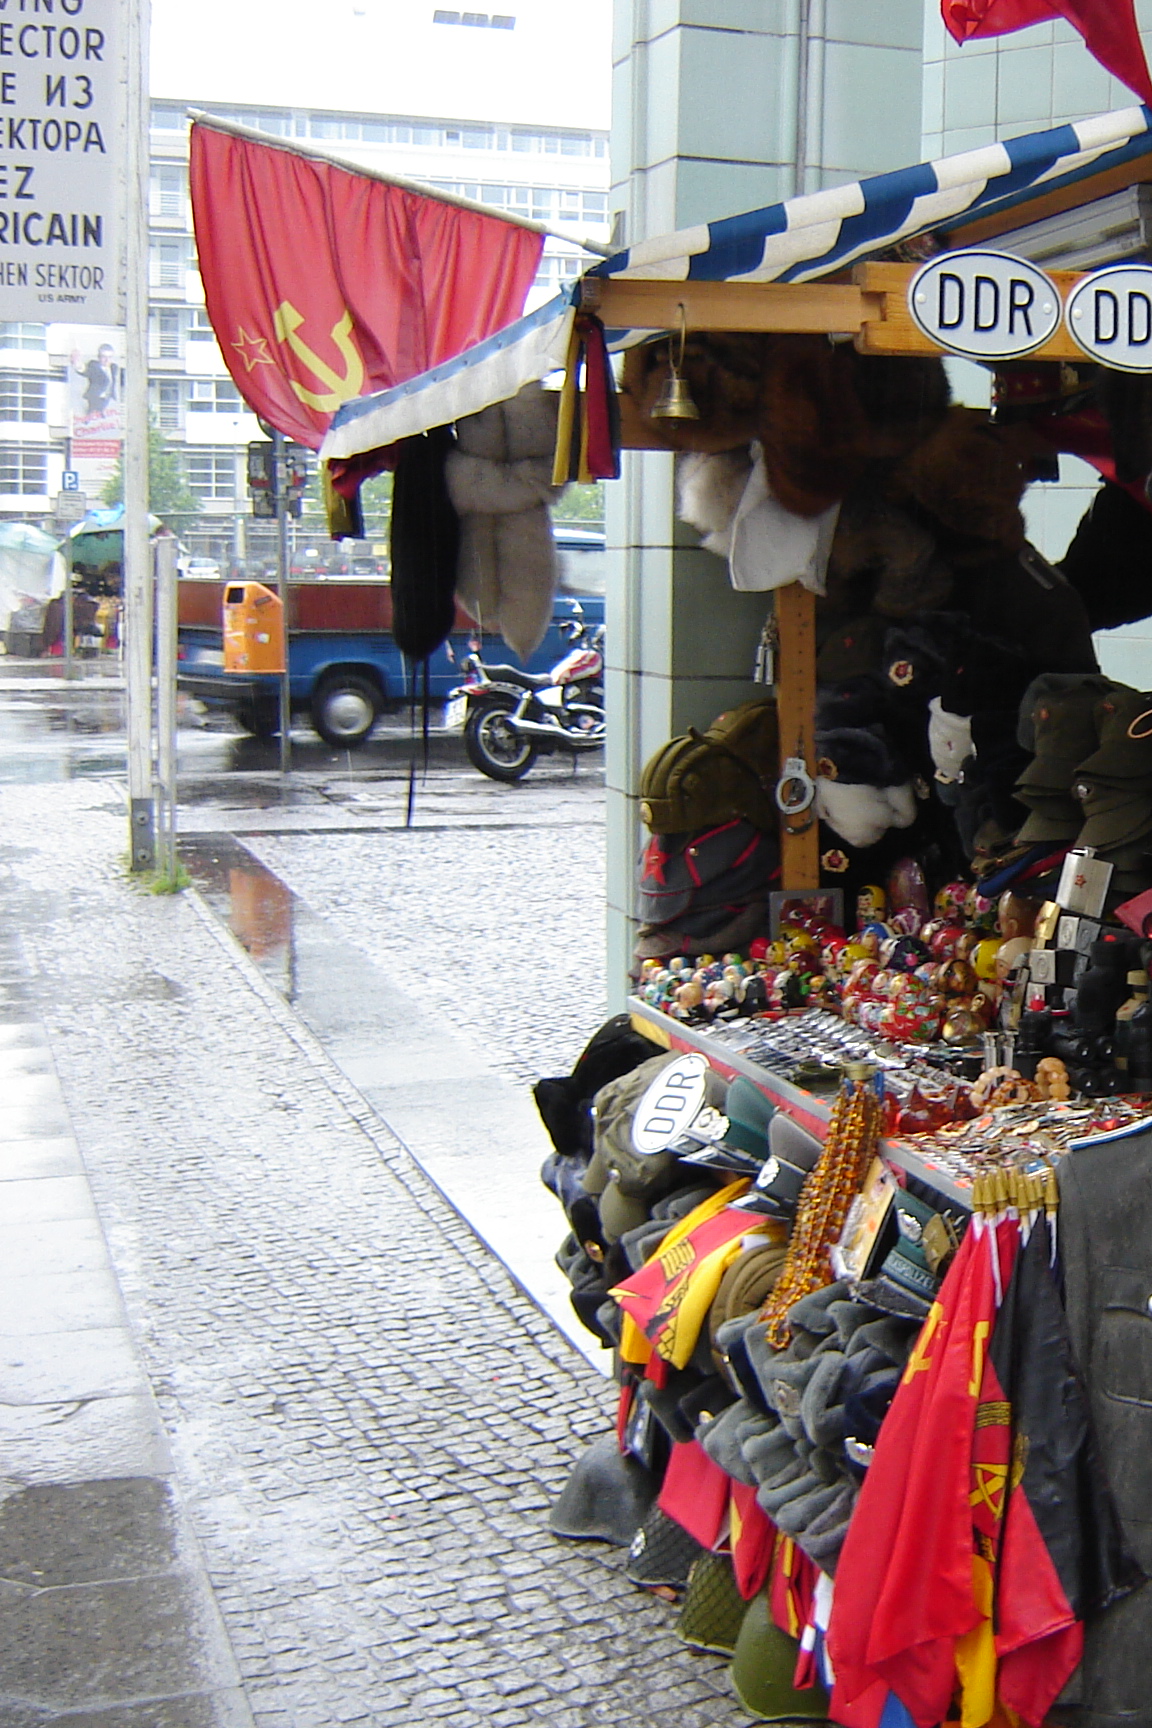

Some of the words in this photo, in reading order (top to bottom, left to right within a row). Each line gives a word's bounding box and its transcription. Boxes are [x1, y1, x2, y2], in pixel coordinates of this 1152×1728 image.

[46, 74, 94, 110] ИЗ
[0, 117, 106, 154] КТОРА
[35, 263, 104, 290] SEKTOR
[38, 294, 55, 303] US
[57, 294, 87, 305] ARMY
[938, 272, 1035, 337] DDR
[643, 1072, 701, 1135] DDR
